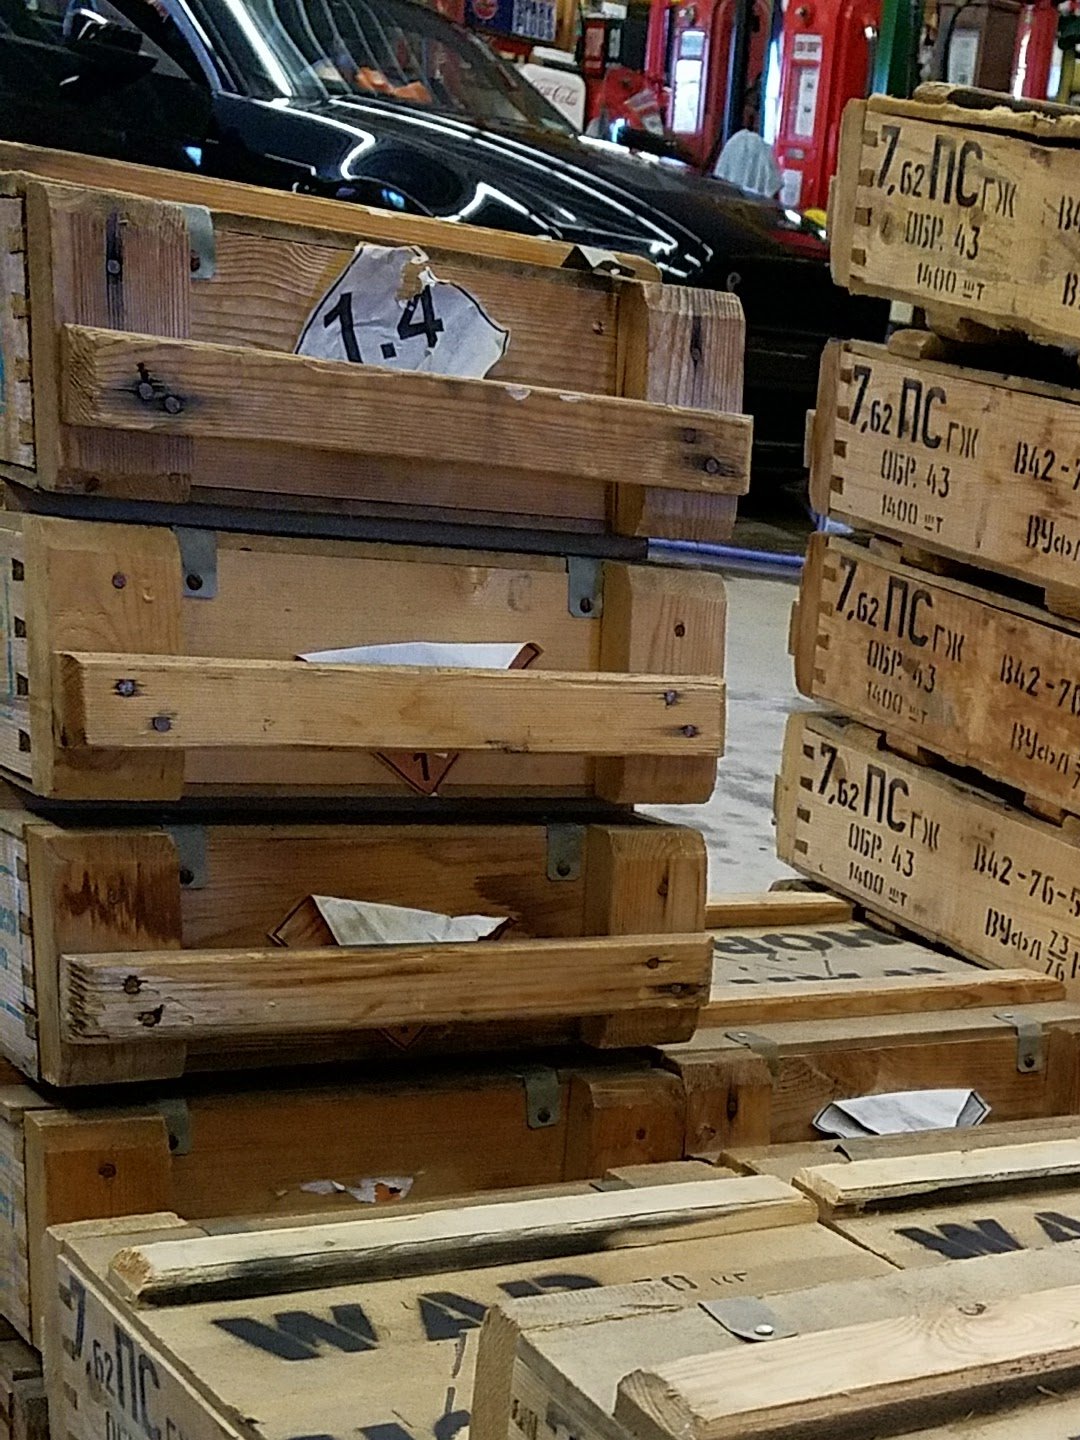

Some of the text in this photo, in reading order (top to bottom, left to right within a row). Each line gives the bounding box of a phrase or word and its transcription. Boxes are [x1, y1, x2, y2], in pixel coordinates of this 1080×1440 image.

[954, 224, 981, 261] 43
[323, 284, 444, 363] 1.4
[926, 462, 950, 498] 43
[912, 661, 936, 693] 43
[413, 752, 430, 781] 1
[891, 840, 915, 877] 43
